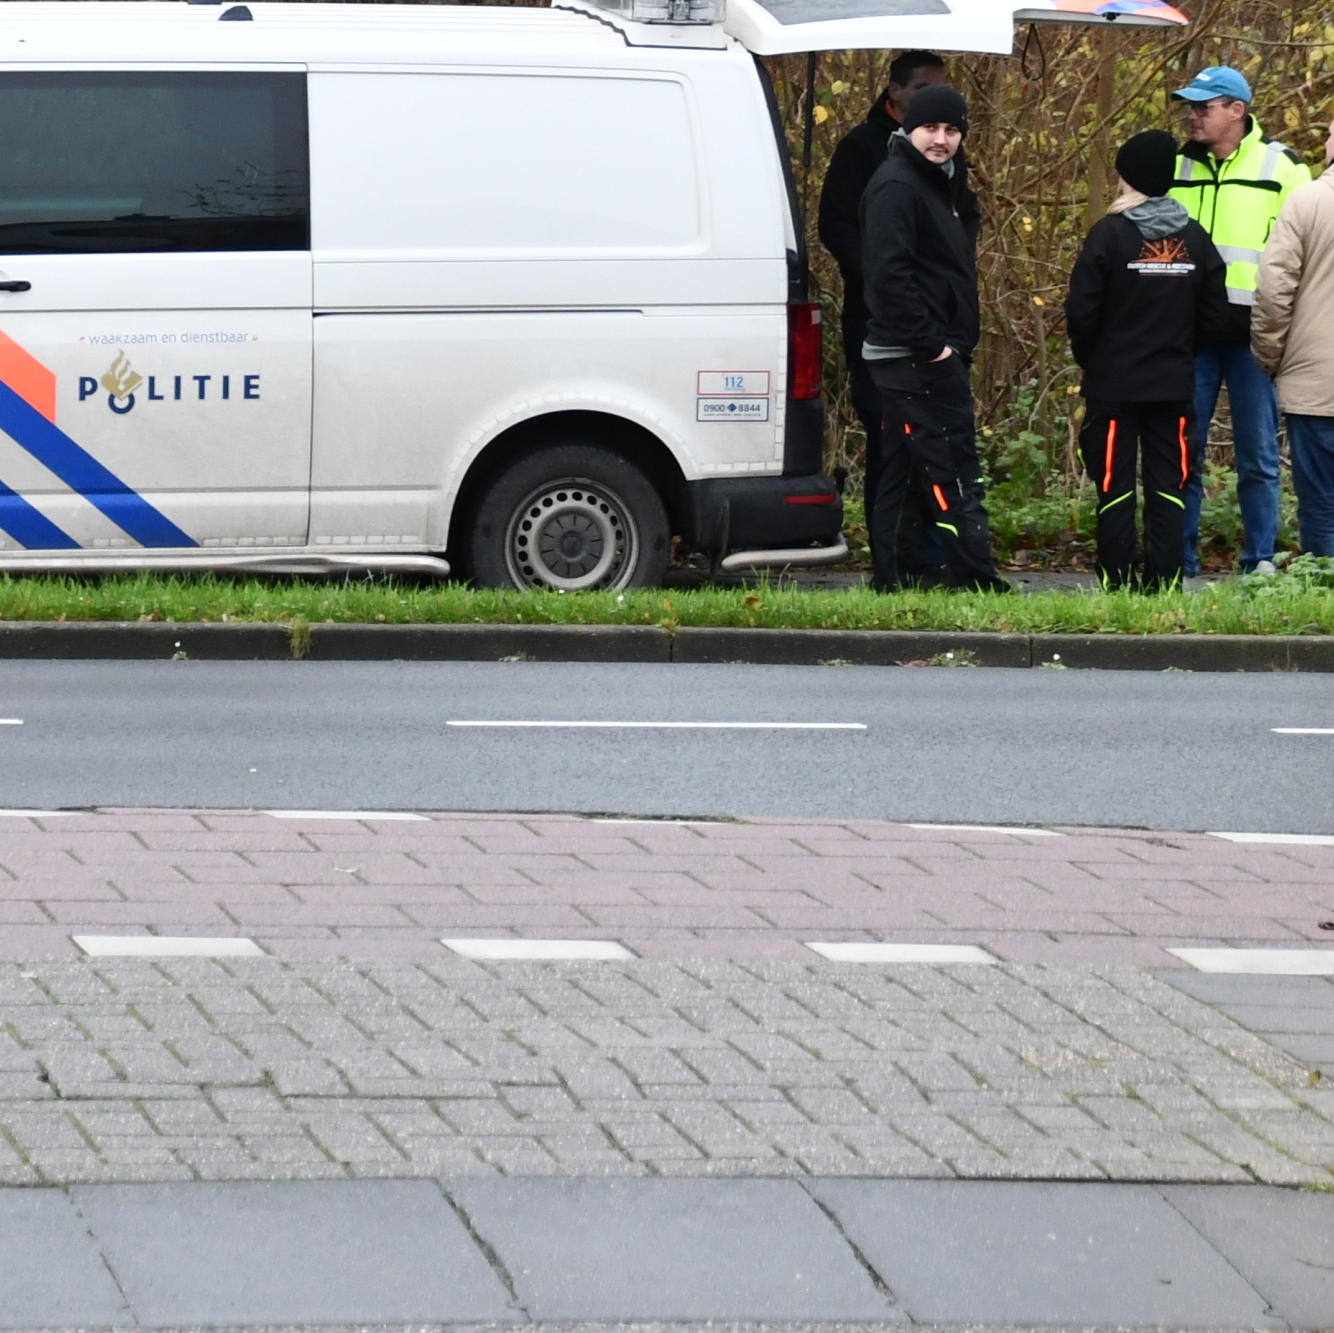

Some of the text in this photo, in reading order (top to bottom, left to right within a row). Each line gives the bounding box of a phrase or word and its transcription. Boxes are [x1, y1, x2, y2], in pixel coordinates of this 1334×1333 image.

[88, 331, 249, 345] waakzaam en dienstbaar
[78, 374, 260, 414] POLITIE
[703, 404, 761, 413] 0900 8844
